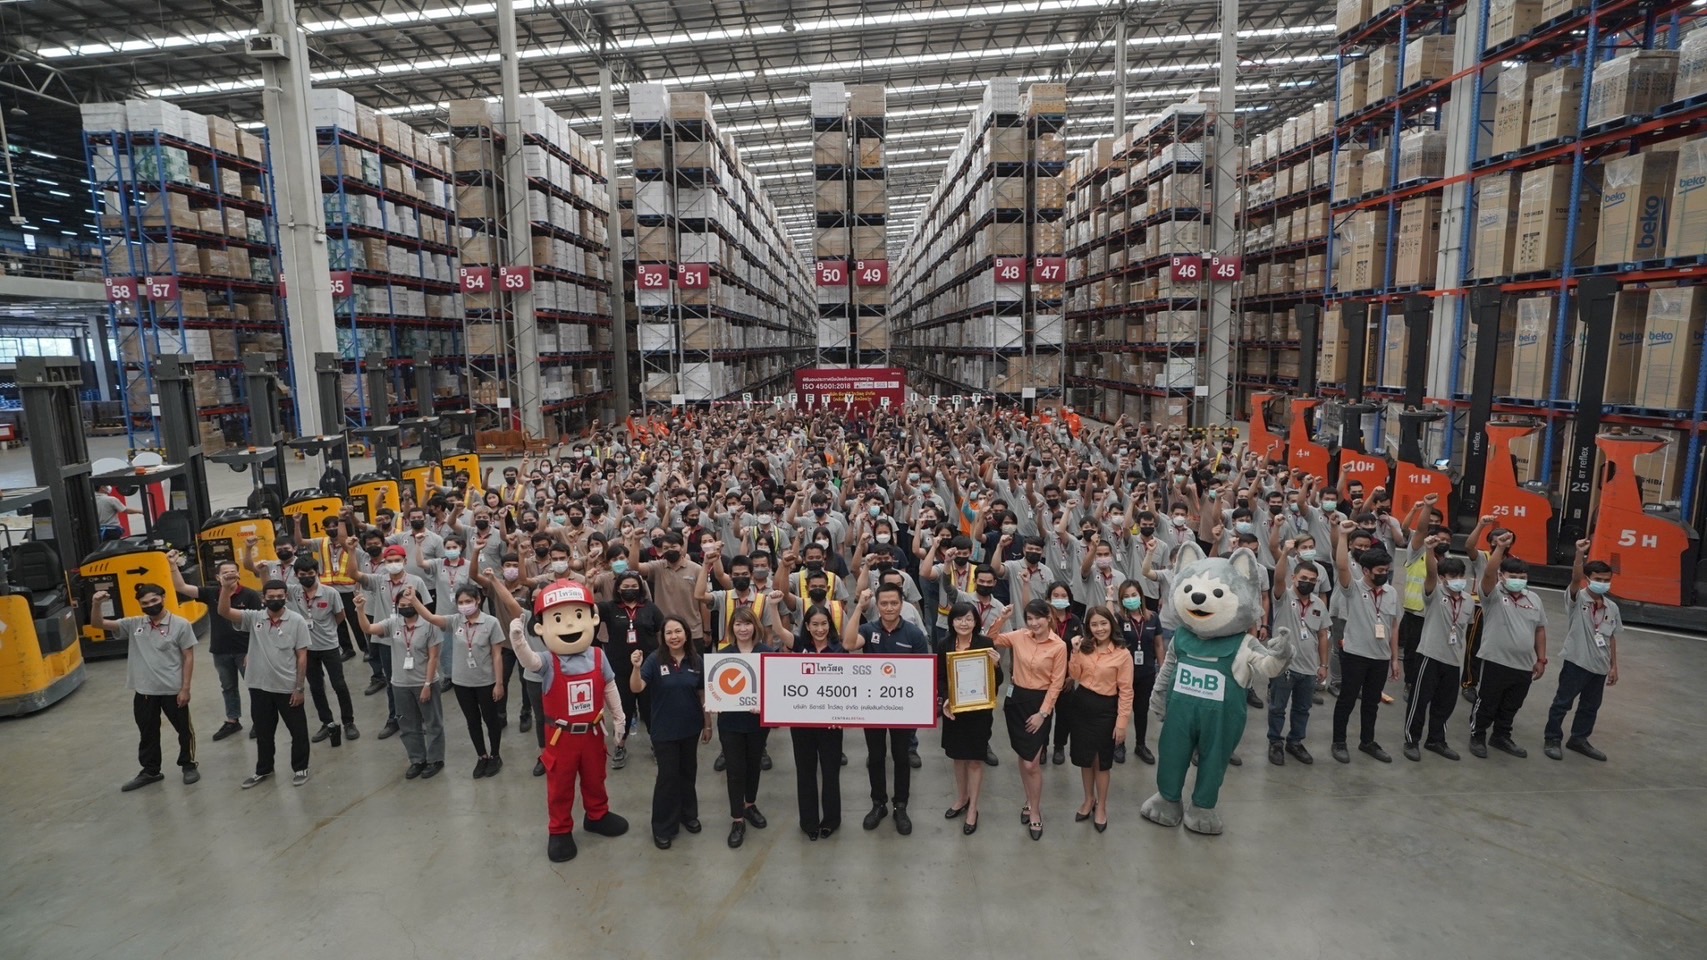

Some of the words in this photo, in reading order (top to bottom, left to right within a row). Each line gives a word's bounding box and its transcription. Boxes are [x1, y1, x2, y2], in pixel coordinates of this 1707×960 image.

[1679, 176, 1707, 188] beko
[1604, 192, 1626, 203] beko
[1636, 195, 1660, 249] beko
[638, 266, 645, 274] B
[644, 274, 662, 286] 52
[679, 265, 686, 274] B
[685, 272, 702, 285] 51
[817, 262, 824, 270] B
[822, 269, 840, 282] 50
[857, 261, 864, 270] B
[863, 269, 881, 282] 49
[996, 258, 1003, 267] B
[1001, 266, 1020, 278] 48
[1036, 258, 1043, 267] B
[1041, 266, 1060, 278] 47
[1173, 258, 1180, 266] B
[1178, 264, 1196, 277] 46
[1212, 257, 1220, 266] B
[1217, 264, 1235, 276] 45
[460, 268, 467, 276] B
[466, 275, 484, 288] 54
[500, 267, 507, 276] B
[506, 274, 524, 287] 53
[105, 278, 112, 286] B
[112, 285, 129, 298] 58
[146, 277, 153, 286] B
[152, 284, 170, 297] 57
[1619, 332, 1643, 341] beko
[1648, 331, 1673, 340] beko
[930, 396, 937, 404] S
[954, 396, 961, 404] R
[973, 393, 981, 401] T
[1473, 432, 1481, 450] reflex
[1579, 446, 1589, 466] reflex
[1422, 475, 1431, 484] H
[1571, 482, 1590, 492] 25
[1493, 505, 1509, 516] 25
[1514, 506, 1526, 517] H
[1618, 530, 1637, 546] 5
[1642, 535, 1657, 548] H
[816, 662, 843, 674] ไทวัสดุ
[852, 665, 872, 675] SGS
[1179, 668, 1218, 691] BnB
[739, 696, 757, 706] SGS
[783, 685, 808, 698] ISO
[817, 685, 858, 698] 45001
[880, 686, 914, 698] 2018
